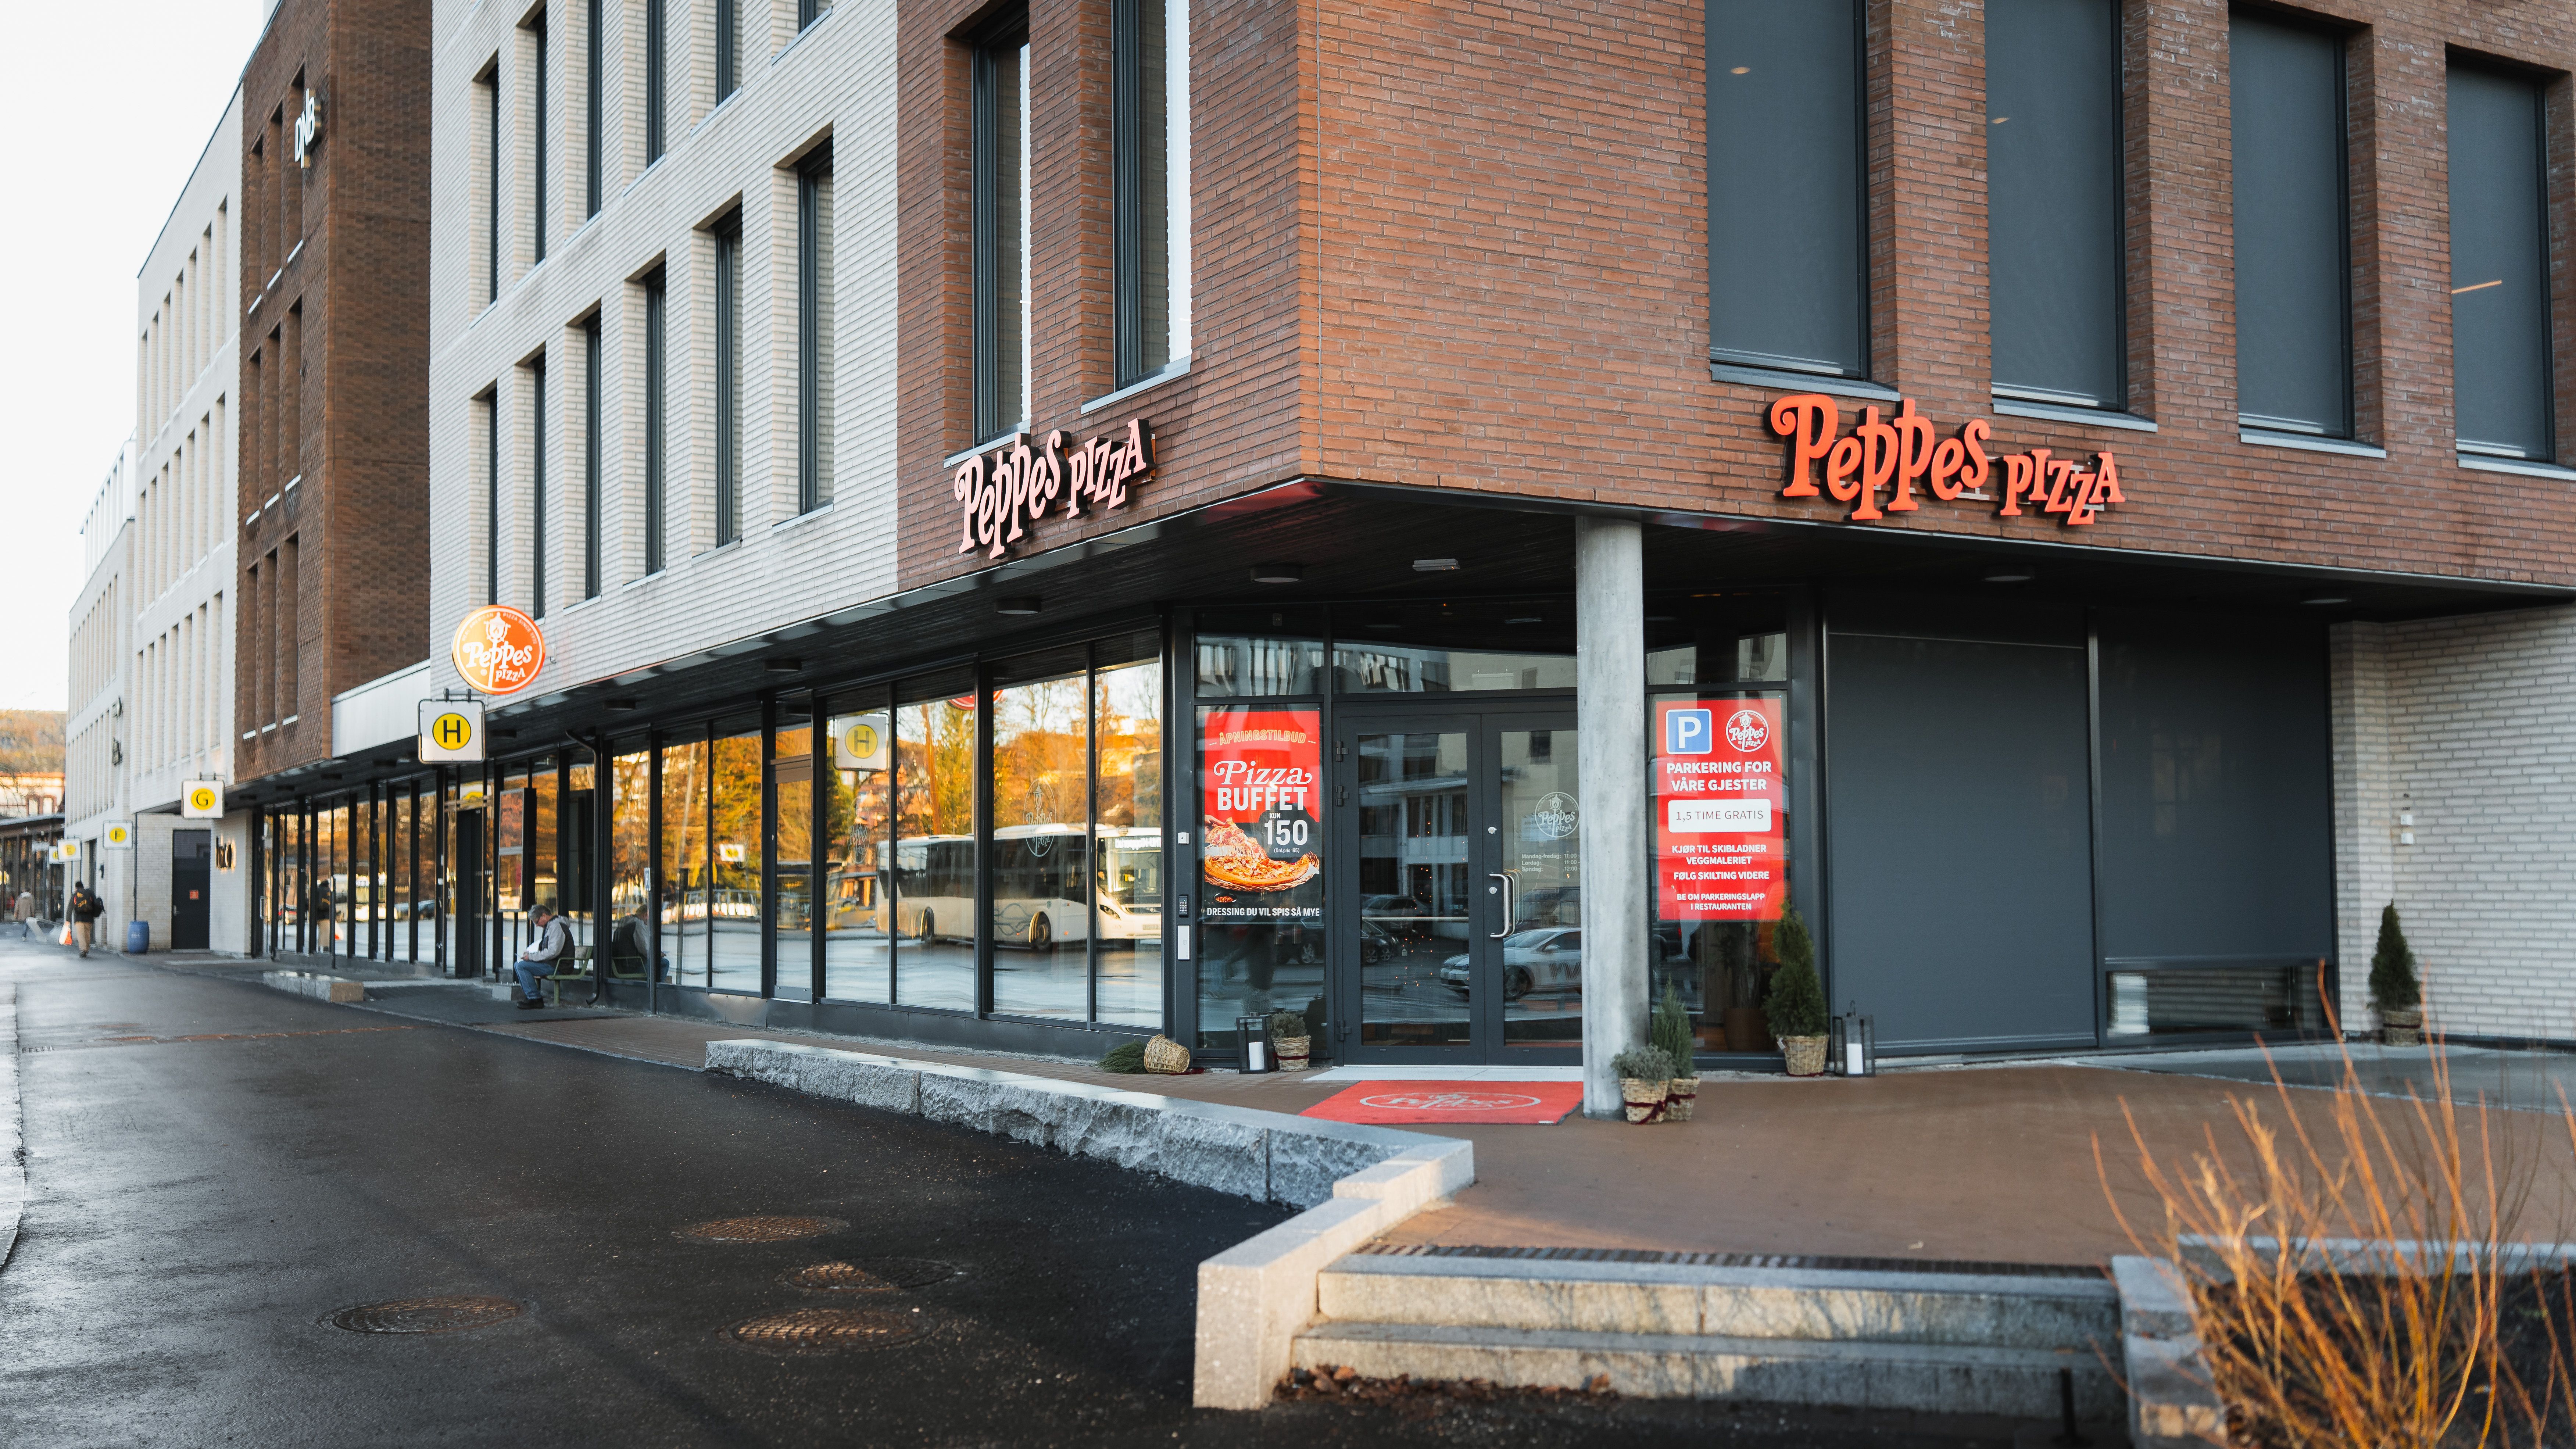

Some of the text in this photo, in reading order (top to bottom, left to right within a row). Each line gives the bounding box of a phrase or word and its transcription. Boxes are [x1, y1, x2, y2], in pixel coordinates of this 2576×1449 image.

[1771, 394, 1991, 520] Peppes
[954, 429, 1061, 560] Peppes
[503, 612, 518, 621] PIZZA
[518, 619, 532, 633] SINCE
[462, 640, 533, 669] Peppes
[443, 720, 461, 743] H
[1219, 729, 1306, 746] ÅPNINGSTILBUD
[1729, 726, 1764, 741] Peppes
[1213, 761, 1312, 785] Pizza
[1666, 761, 1772, 774] PARKERING FOR
[1671, 777, 1767, 791] VÅRE GJESTER
[196, 791, 208, 806] G
[1218, 787, 1307, 811] BUFFET
[1538, 809, 1575, 825] Peppes
[1676, 810, 1764, 822] 1,5 TIME GRATIS
[1264, 820, 1308, 845] 150
[1672, 844, 1767, 854] KJØR TIL SKIBLADNER
[1686, 856, 1752, 865] VEGGMALERIET
[1674, 871, 1770, 880] FØLG SKILTING VIDERE
[1207, 906, 1320, 916] DRESSING DU VIL SPIS SÅ MYE
